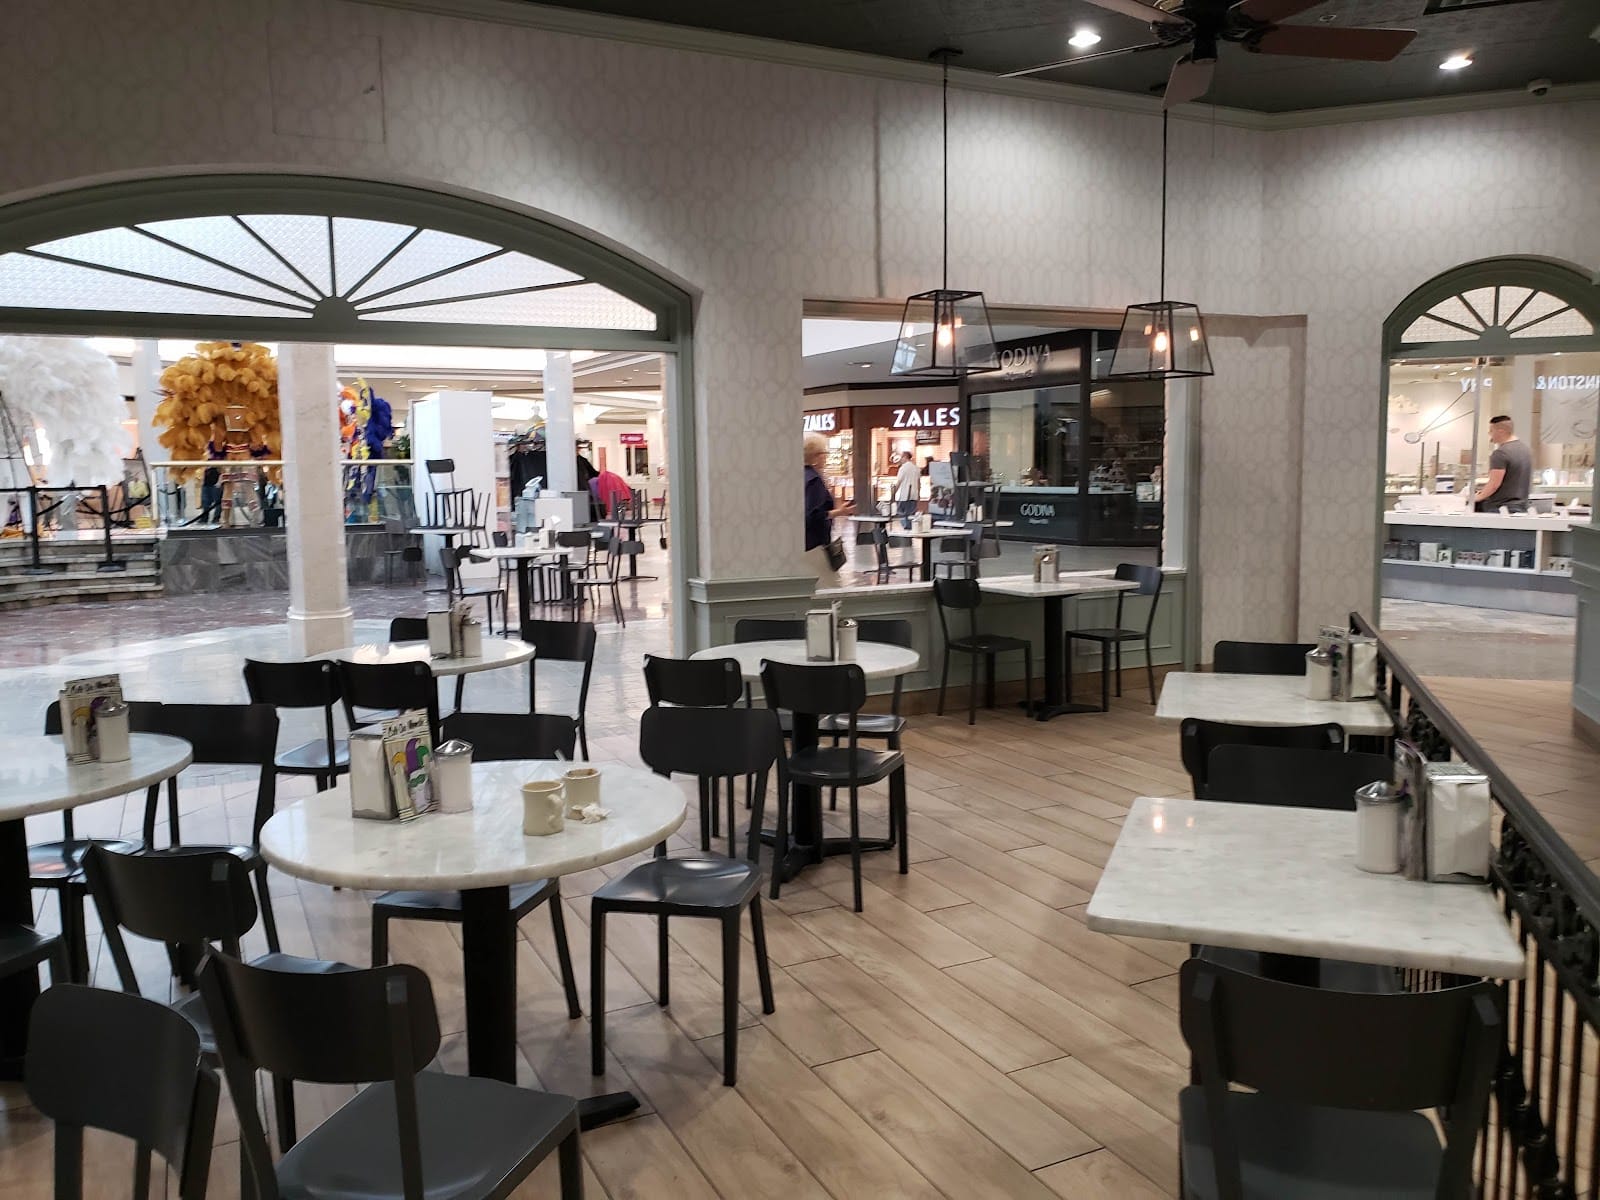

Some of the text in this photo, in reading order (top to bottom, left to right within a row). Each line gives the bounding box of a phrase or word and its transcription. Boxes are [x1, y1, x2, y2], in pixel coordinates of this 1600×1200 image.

[803, 413, 836, 432] ZALES
[892, 407, 961, 428] ZALES
[1020, 503, 1056, 517] GODIVA
